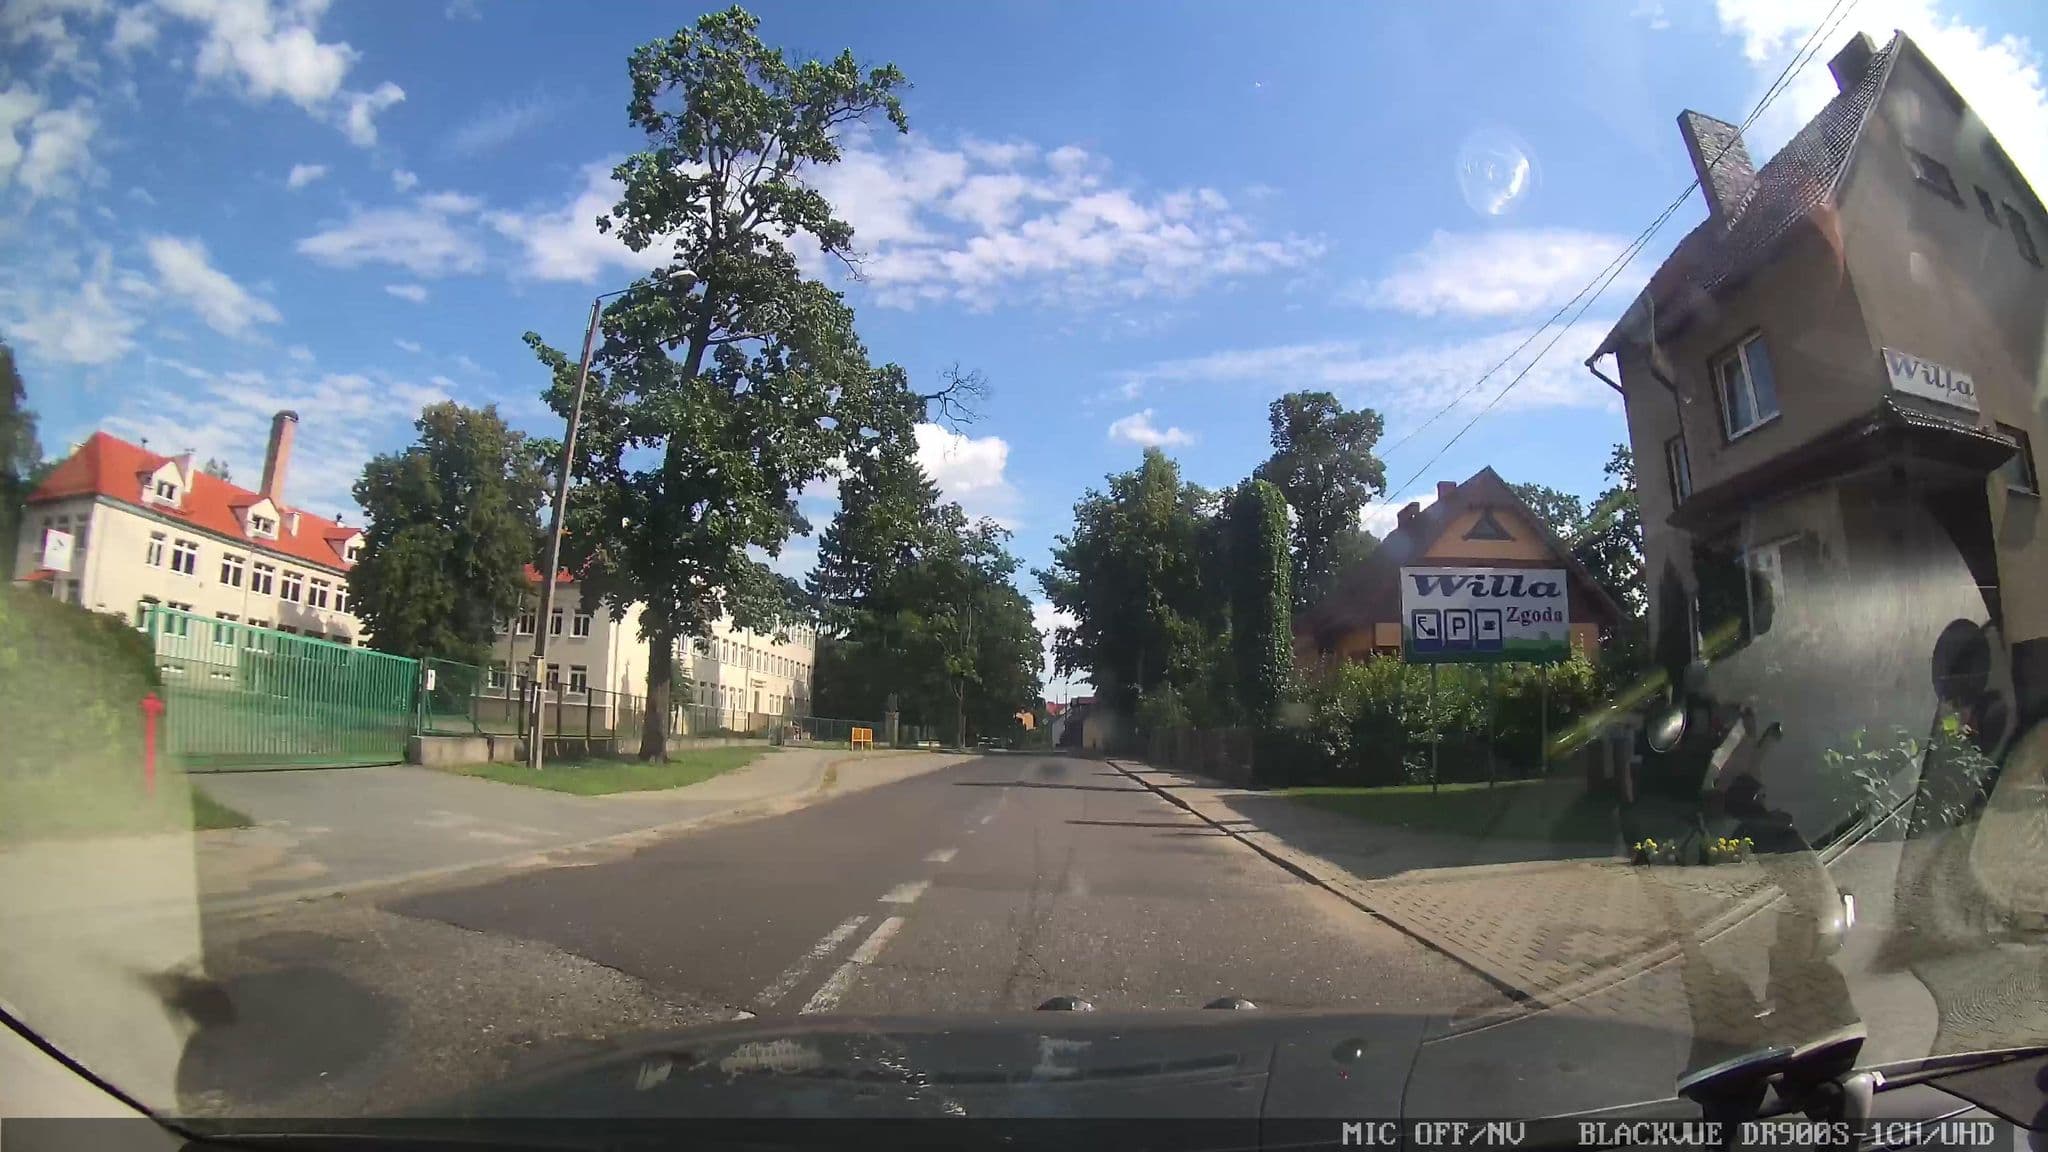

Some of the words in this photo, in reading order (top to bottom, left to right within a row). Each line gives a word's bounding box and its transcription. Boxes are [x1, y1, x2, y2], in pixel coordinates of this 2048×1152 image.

[1888, 350, 1974, 396] Willa
[1409, 574, 1562, 598] Willa
[1506, 606, 1563, 626] Zgoda
